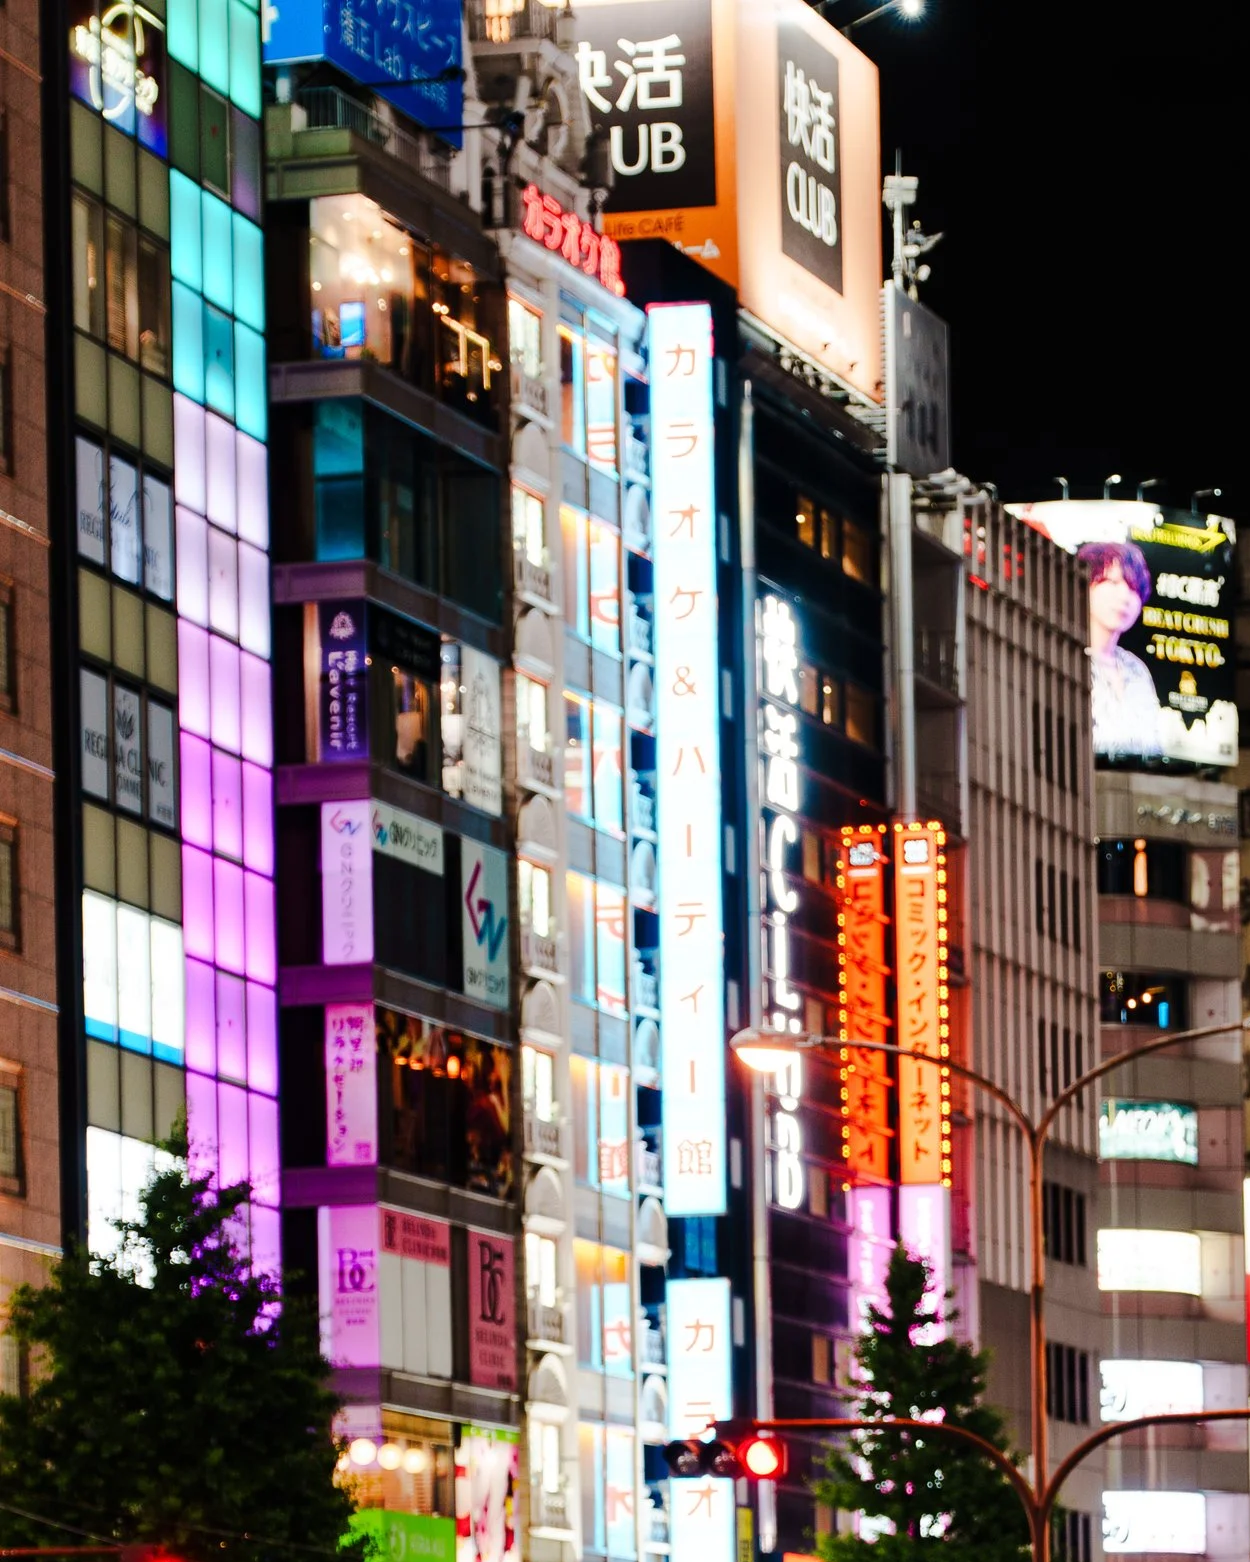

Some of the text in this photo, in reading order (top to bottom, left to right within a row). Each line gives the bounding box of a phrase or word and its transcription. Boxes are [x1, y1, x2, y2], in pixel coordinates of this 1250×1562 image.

[610, 122, 686, 176] UB
[783, 60, 836, 174] 快活
[786, 161, 837, 247] CLUB
[84, 727, 168, 788] REGA CLNIC
